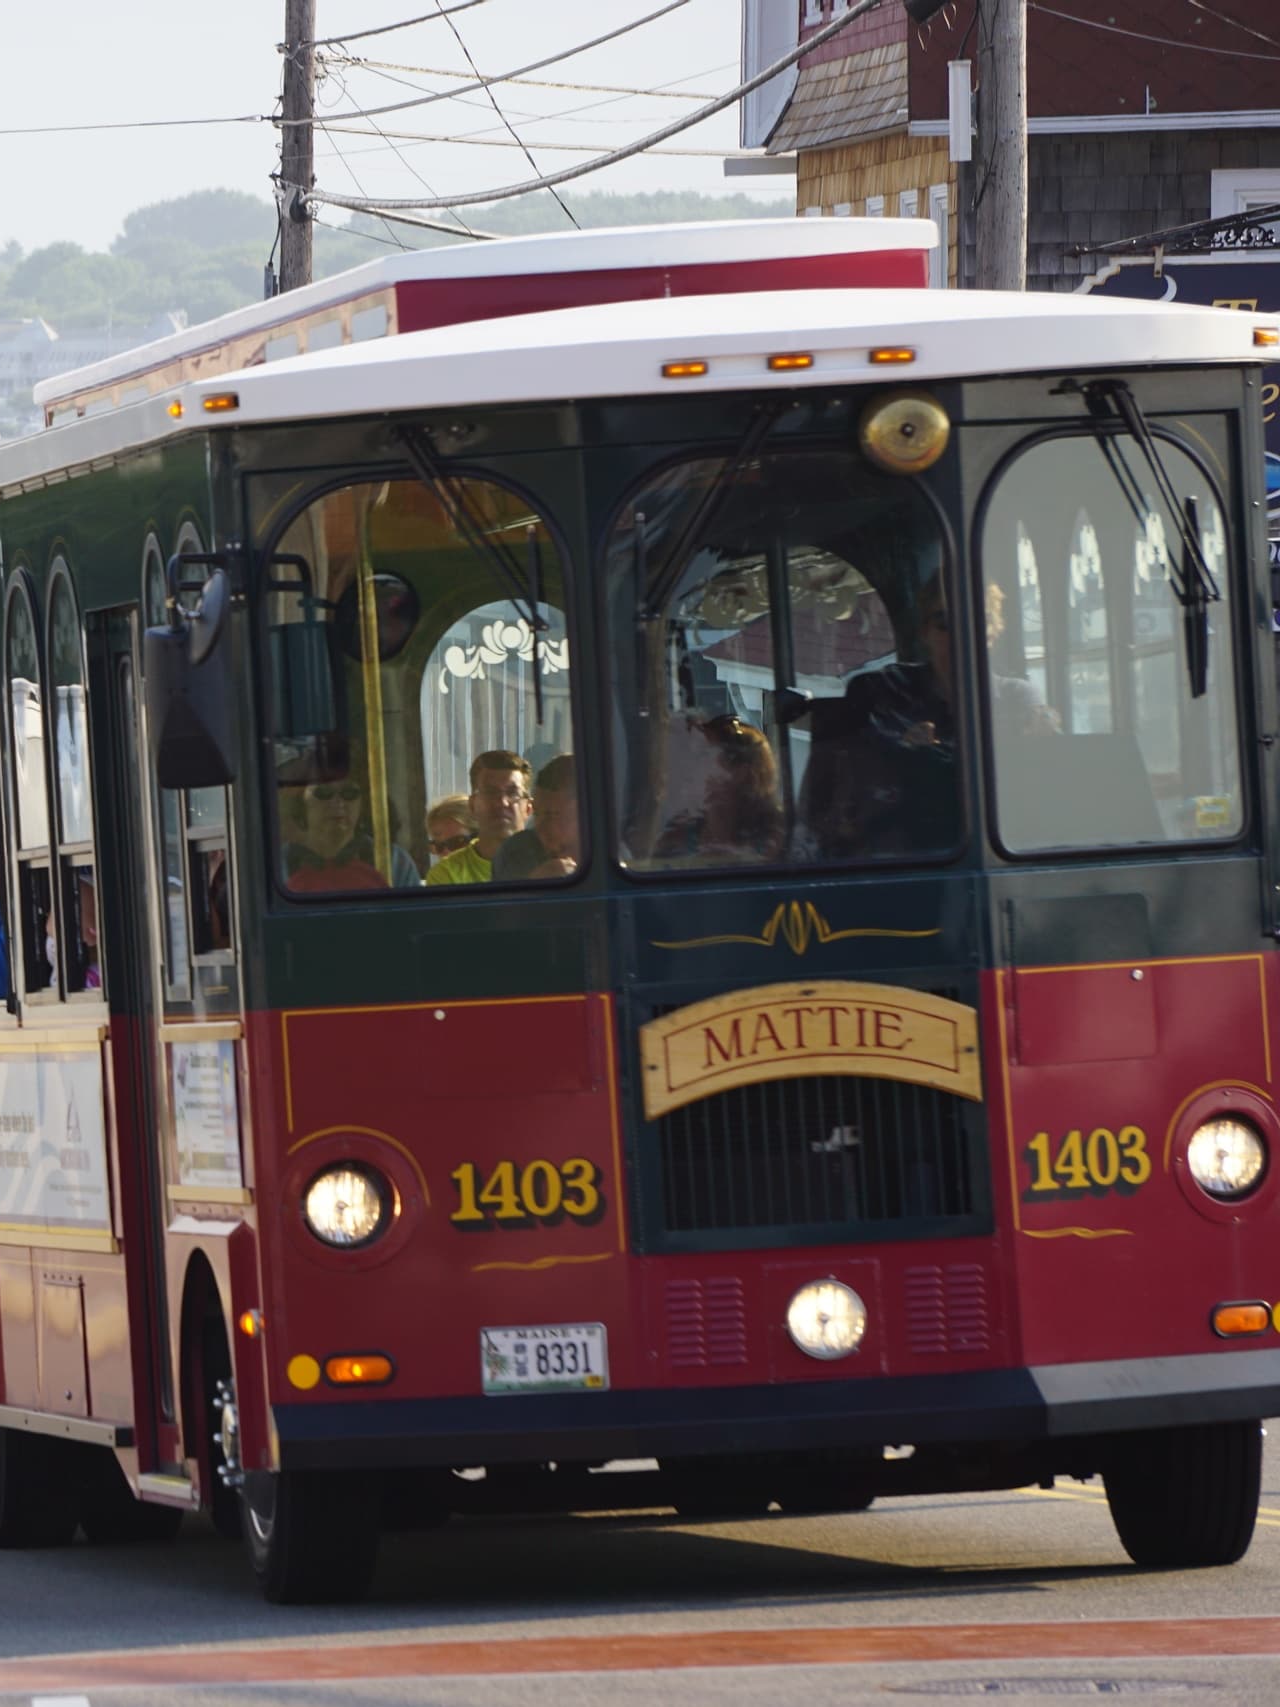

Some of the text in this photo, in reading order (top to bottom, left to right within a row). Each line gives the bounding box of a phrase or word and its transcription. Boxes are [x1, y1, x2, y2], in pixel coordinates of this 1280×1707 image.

[701, 1005, 914, 1070] MATTIE
[449, 1157, 601, 1223] 1403
[1026, 1126, 1151, 1193] 1403
[516, 1328, 570, 1340] MAINE
[535, 1341, 593, 1376] 8331
